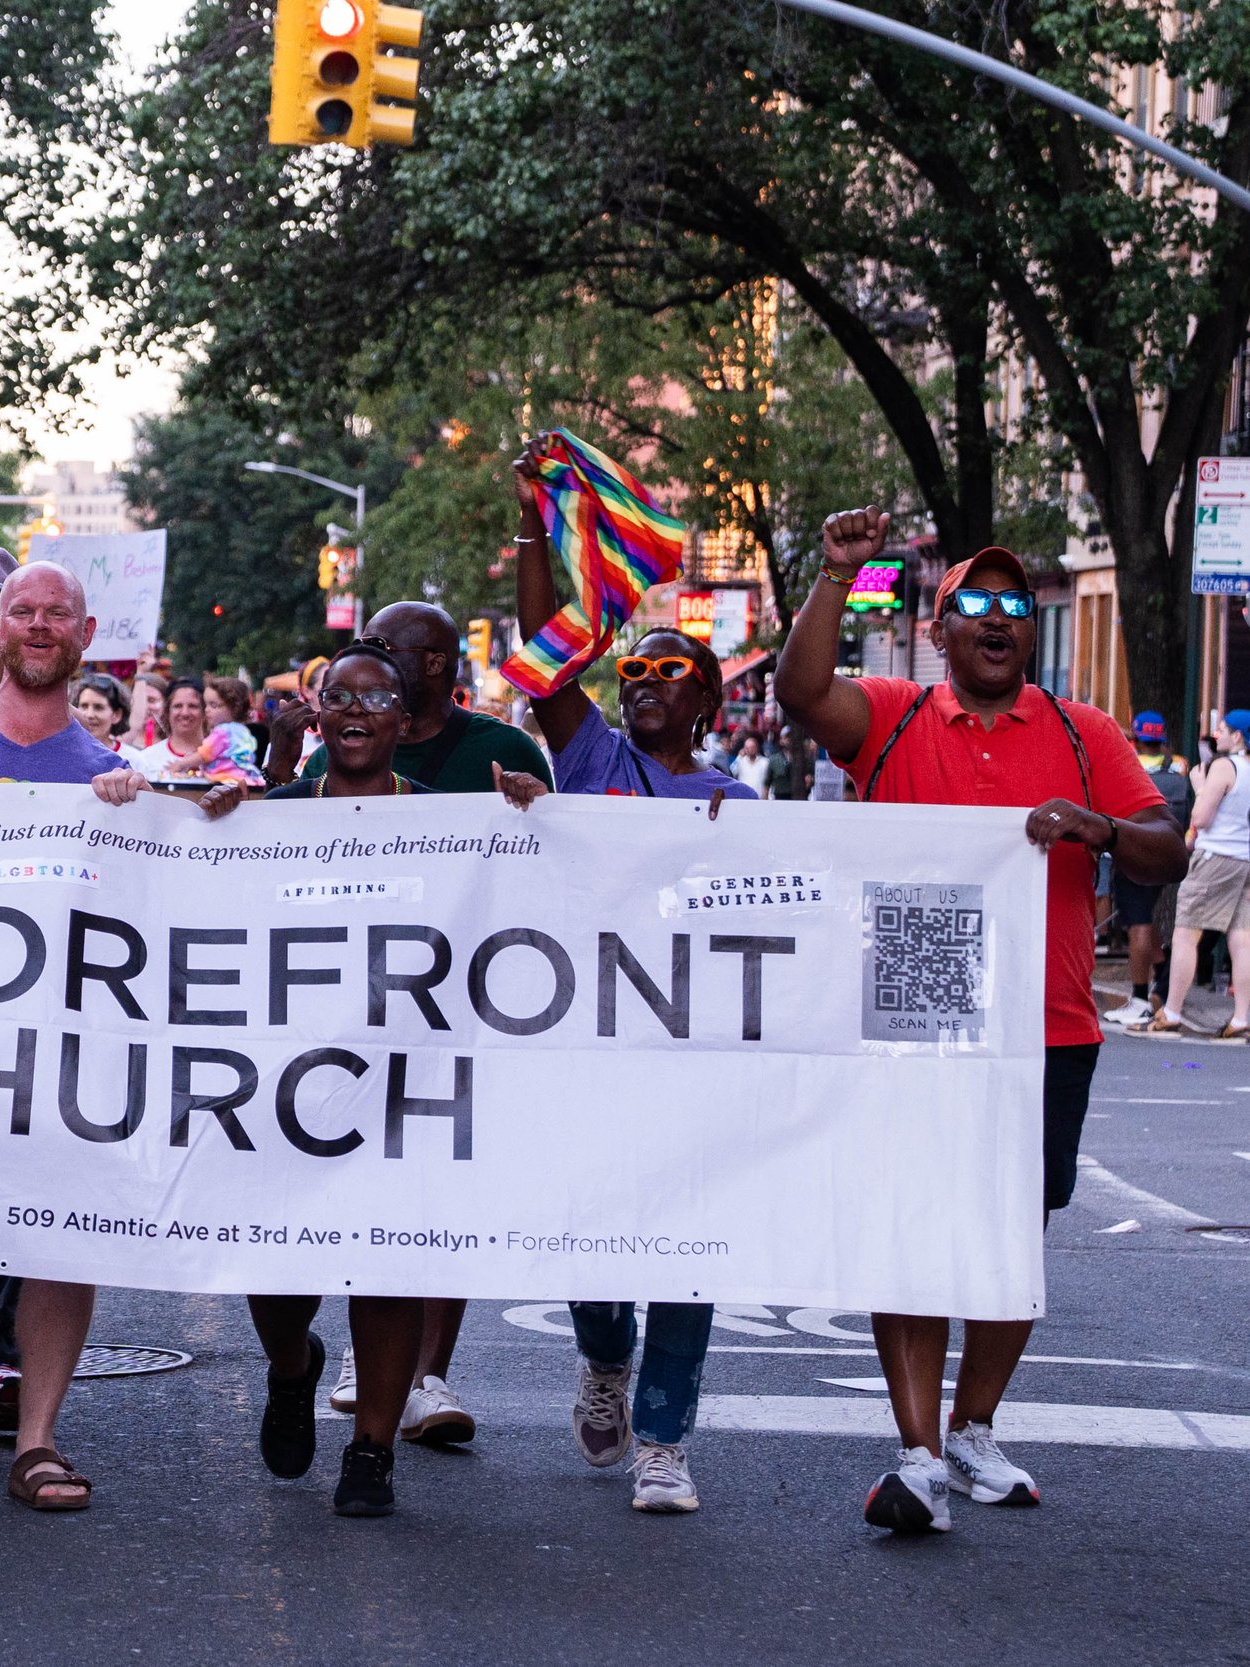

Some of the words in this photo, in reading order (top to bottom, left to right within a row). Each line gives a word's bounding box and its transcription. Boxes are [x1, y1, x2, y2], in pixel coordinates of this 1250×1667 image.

[858, 567, 899, 582] DOO
[852, 581, 890, 592] EEN
[679, 597, 713, 620] BOG
[40, 820, 86, 839] and
[87, 826, 183, 859] generous
[187, 841, 308, 866] expression
[314, 838, 343, 864] of
[343, 837, 377, 859] the
[382, 834, 484, 857] christian
[482, 833, 541, 859] faith
[283, 884, 387, 898] AFFIRMING
[710, 875, 816, 891] GENDER-
[688, 889, 823, 910] EQUITABLE
[874, 887, 921, 904] ABOUT
[939, 890, 958, 904] US
[888, 1017, 927, 1031] SCAN
[938, 1018, 962, 1031] ME
[6, 1206, 55, 1228] 509
[63, 1211, 158, 1238] Atlantic
[166, 1220, 209, 1241] Ave
[217, 1224, 240, 1243] at
[248, 1225, 288, 1244] 3rd
[297, 1227, 342, 1245] Ave
[370, 1227, 478, 1252] Brooklyn
[507, 1231, 729, 1256] ForefrontNYC.com
